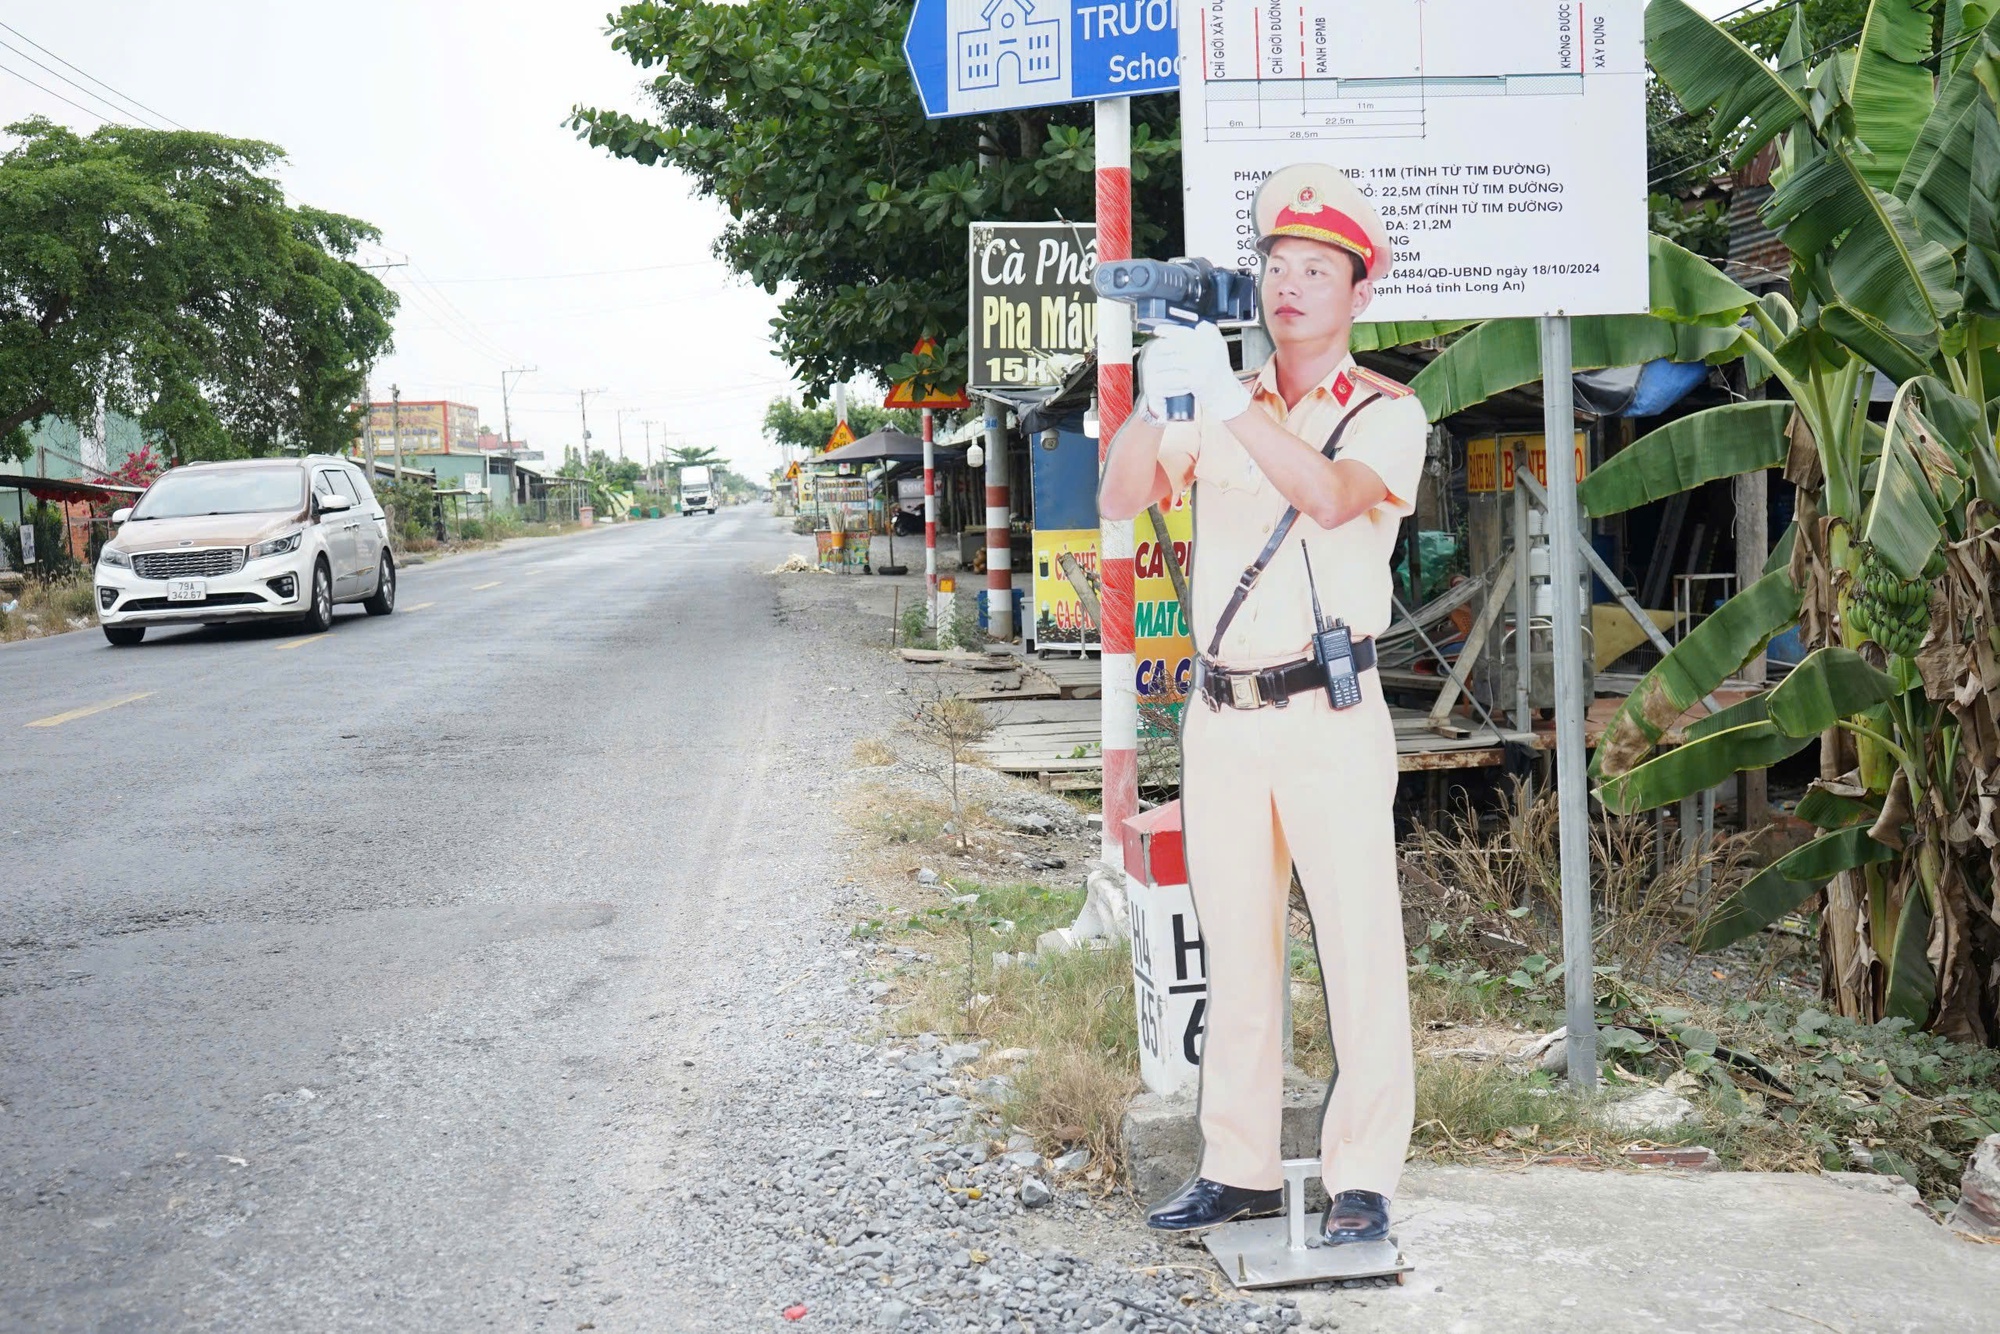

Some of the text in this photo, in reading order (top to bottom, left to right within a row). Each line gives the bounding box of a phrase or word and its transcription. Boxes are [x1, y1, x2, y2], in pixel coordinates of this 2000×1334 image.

[1210, 15, 1224, 35] XÂY
[1558, 4, 1571, 68] KHÔNG ĐƯỢC
[1592, 16, 1606, 68] XÂY DỰNG
[1315, 17, 1327, 73] RANH GPMB
[1325, 118, 1354, 126] 22,5m
[1290, 131, 1318, 139] 28,5m
[1234, 171, 1272, 184] PHẠM
[1370, 168, 1396, 178] 11M
[1401, 165, 1437, 179] (TÍNH
[1442, 165, 1461, 176] TỪ
[1466, 165, 1489, 176] TIM
[1493, 163, 1551, 176] ĐƯỜNG)
[1382, 186, 1421, 198] 22,5M
[1426, 183, 1459, 197] (TÍNH
[1463, 183, 1479, 195] TỪ
[1483, 184, 1504, 194] TIM
[1509, 182, 1564, 194] ĐƯỜNG)
[1381, 205, 1420, 217] 28,5M
[1425, 202, 1458, 216] (TÍNH
[1462, 201, 1479, 213] TỪ
[1482, 203, 1503, 213] TIM
[1508, 200, 1563, 213] ĐƯỜNG)
[1386, 221, 1408, 231] ĐA:
[1413, 219, 1452, 231] 21,2M
[981, 238, 1097, 286] Cà Phê
[1238, 253, 1261, 267] CỐ
[1393, 266, 1492, 279] 6484/QĐ-UBND
[1496, 266, 1528, 279] ngày
[1533, 264, 1600, 275] 18/10/2024
[1407, 283, 1432, 293] Hoá
[1466, 282, 1498, 293] Long
[1503, 281, 1525, 292] An)
[983, 296, 1031, 349] Pha
[1504, 450, 1548, 487] BNH
[179, 582, 194, 590] 79A
[172, 591, 201, 599] 342.67
